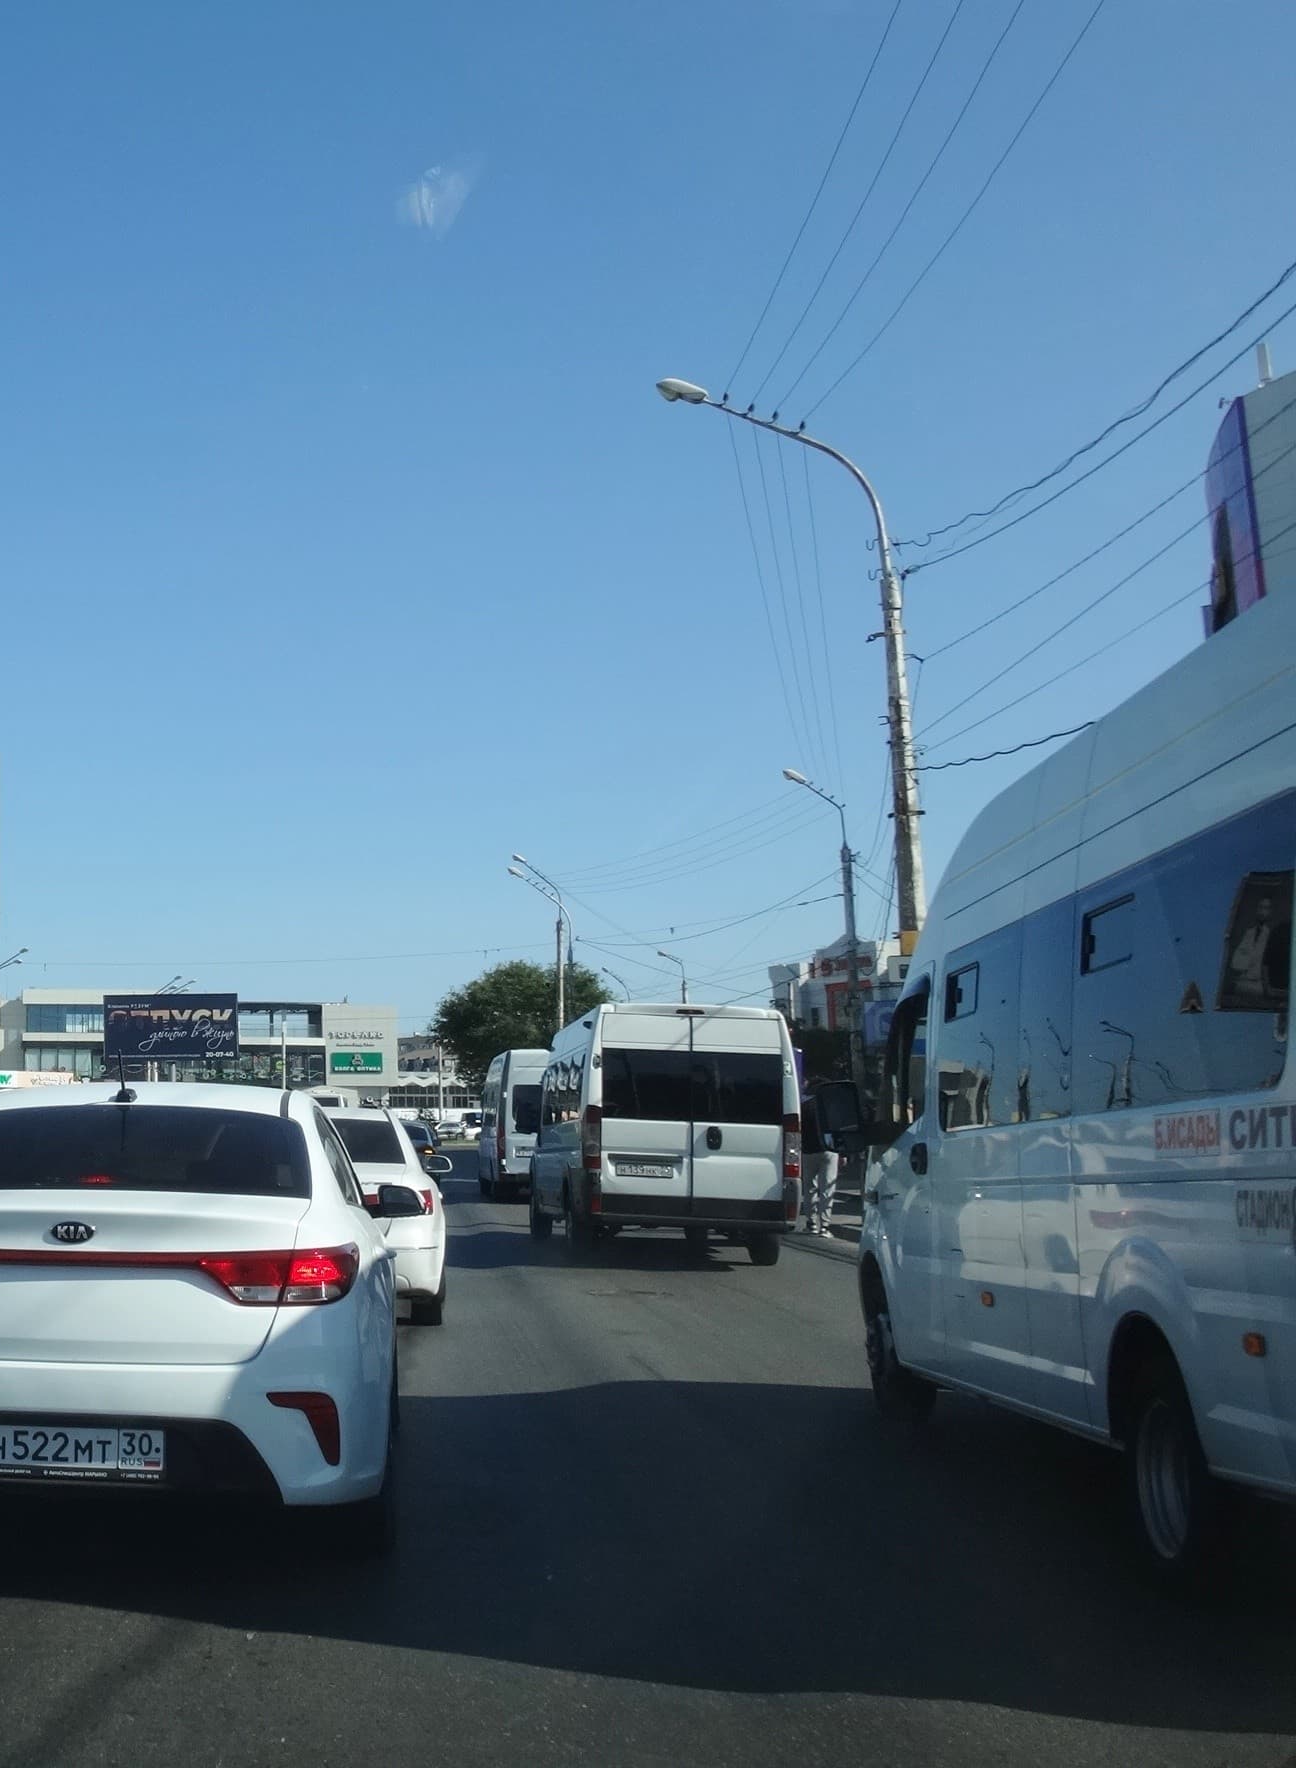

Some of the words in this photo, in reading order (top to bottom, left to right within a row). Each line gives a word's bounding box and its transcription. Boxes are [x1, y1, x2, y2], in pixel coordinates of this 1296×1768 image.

[57, 1225, 88, 1239] KIA
[122, 1432, 153, 1456] 30
[120, 1457, 143, 1466] RUS
